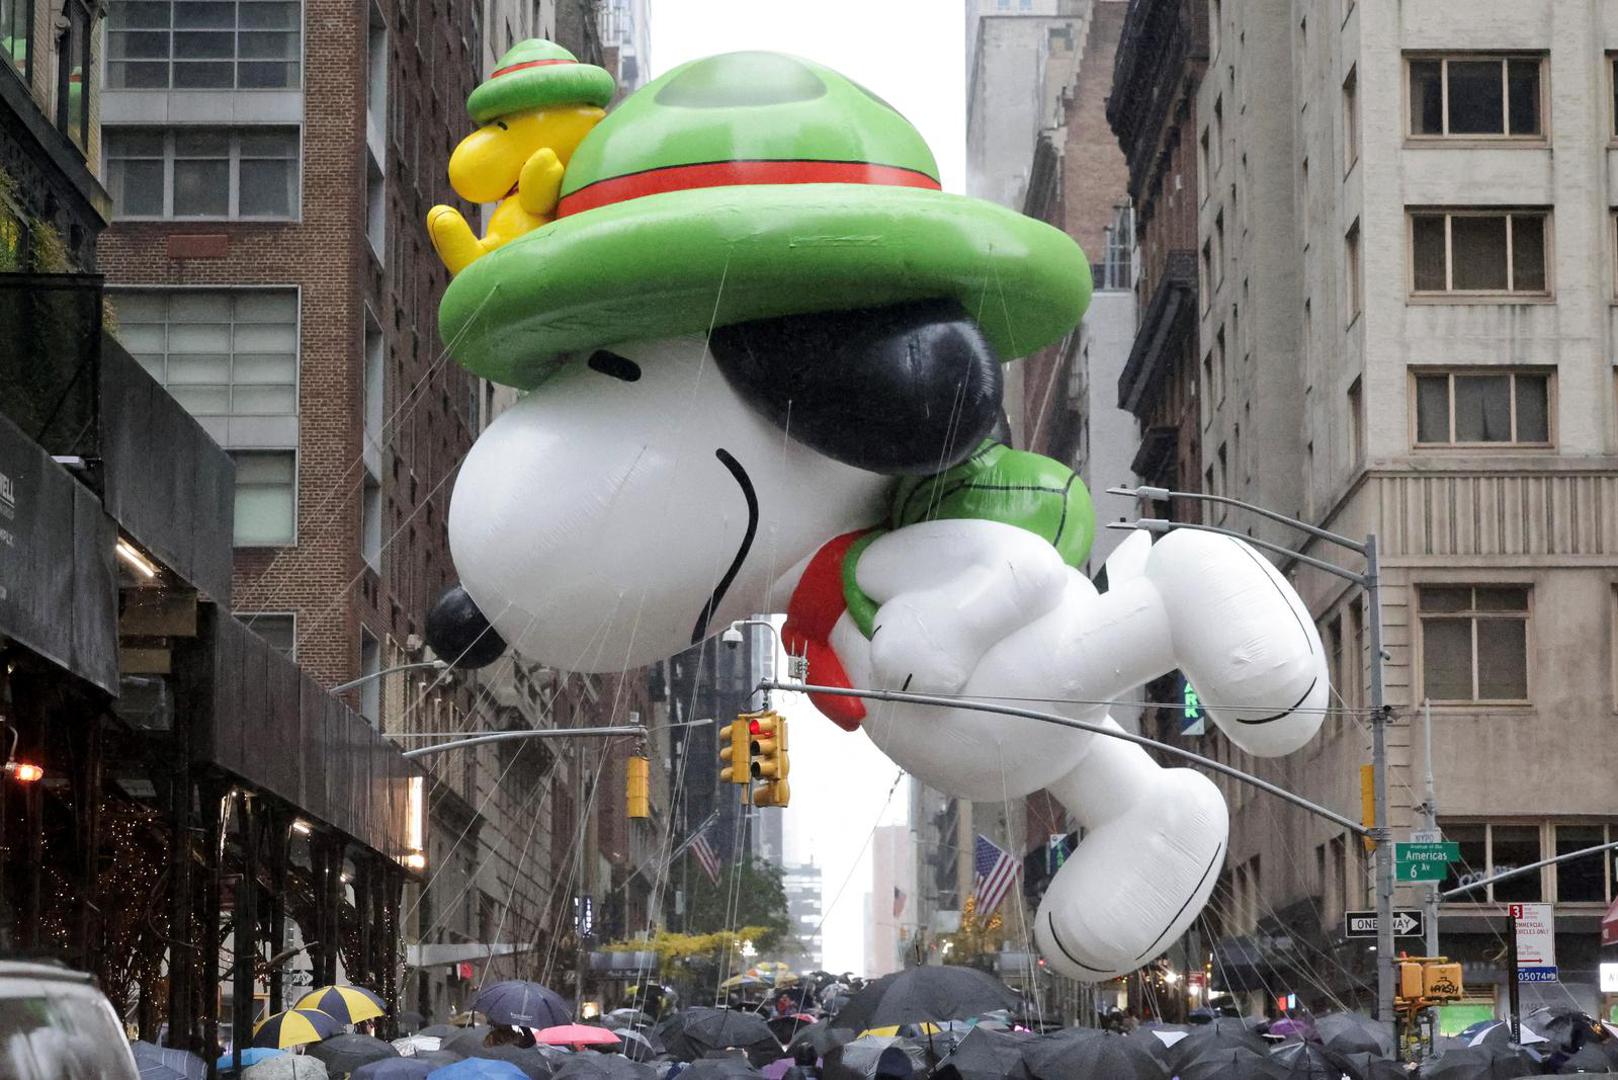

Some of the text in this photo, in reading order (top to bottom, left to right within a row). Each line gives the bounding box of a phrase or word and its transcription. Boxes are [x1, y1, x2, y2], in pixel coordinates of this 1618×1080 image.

[1184, 682, 1199, 718] ARK
[1406, 850, 1447, 861] Americas
[1410, 863, 1430, 878] 6 Av
[1512, 906, 1520, 918] 3
[1357, 919, 1378, 930] ONE
[1518, 972, 1546, 981] 05074
